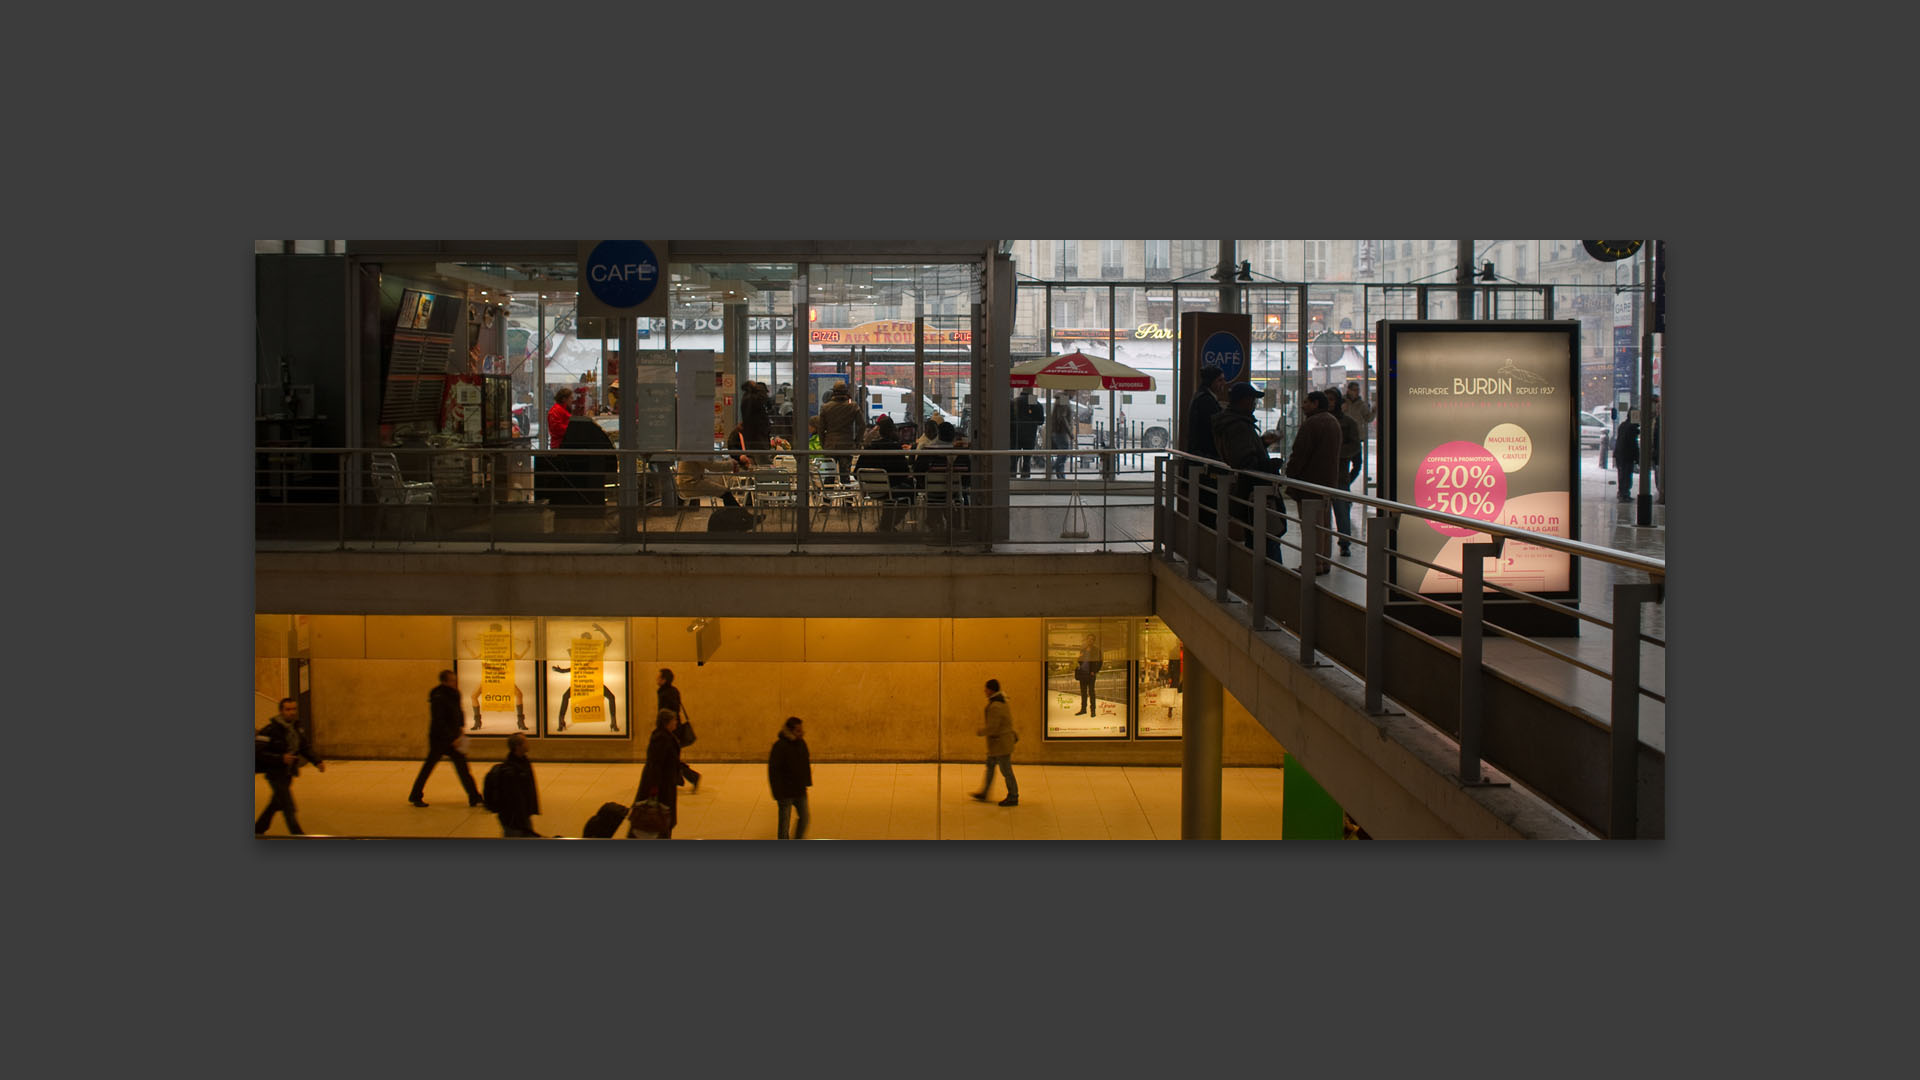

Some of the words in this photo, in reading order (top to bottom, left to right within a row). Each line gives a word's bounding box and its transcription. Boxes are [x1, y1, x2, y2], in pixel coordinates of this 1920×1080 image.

[591, 259, 652, 282] CAFÉ
[1615, 303, 1632, 313] GARE
[694, 318, 723, 331] DU
[877, 324, 888, 332] LE
[891, 322, 912, 332] FEU
[812, 331, 839, 343] PIZZA
[845, 333, 870, 343] AUX
[873, 331, 944, 344] TROUSES
[1205, 350, 1240, 365] CAFÉ
[1453, 378, 1511, 395] BURDIN
[1516, 387, 1537, 395] DEPUIS
[1488, 436, 1527, 444] MAQUILLAGE
[1509, 515, 1518, 525] A
[1522, 515, 1545, 525] 100
[1548, 517, 1560, 525] m
[485, 694, 511, 702] eram
[574, 705, 601, 713] eram
